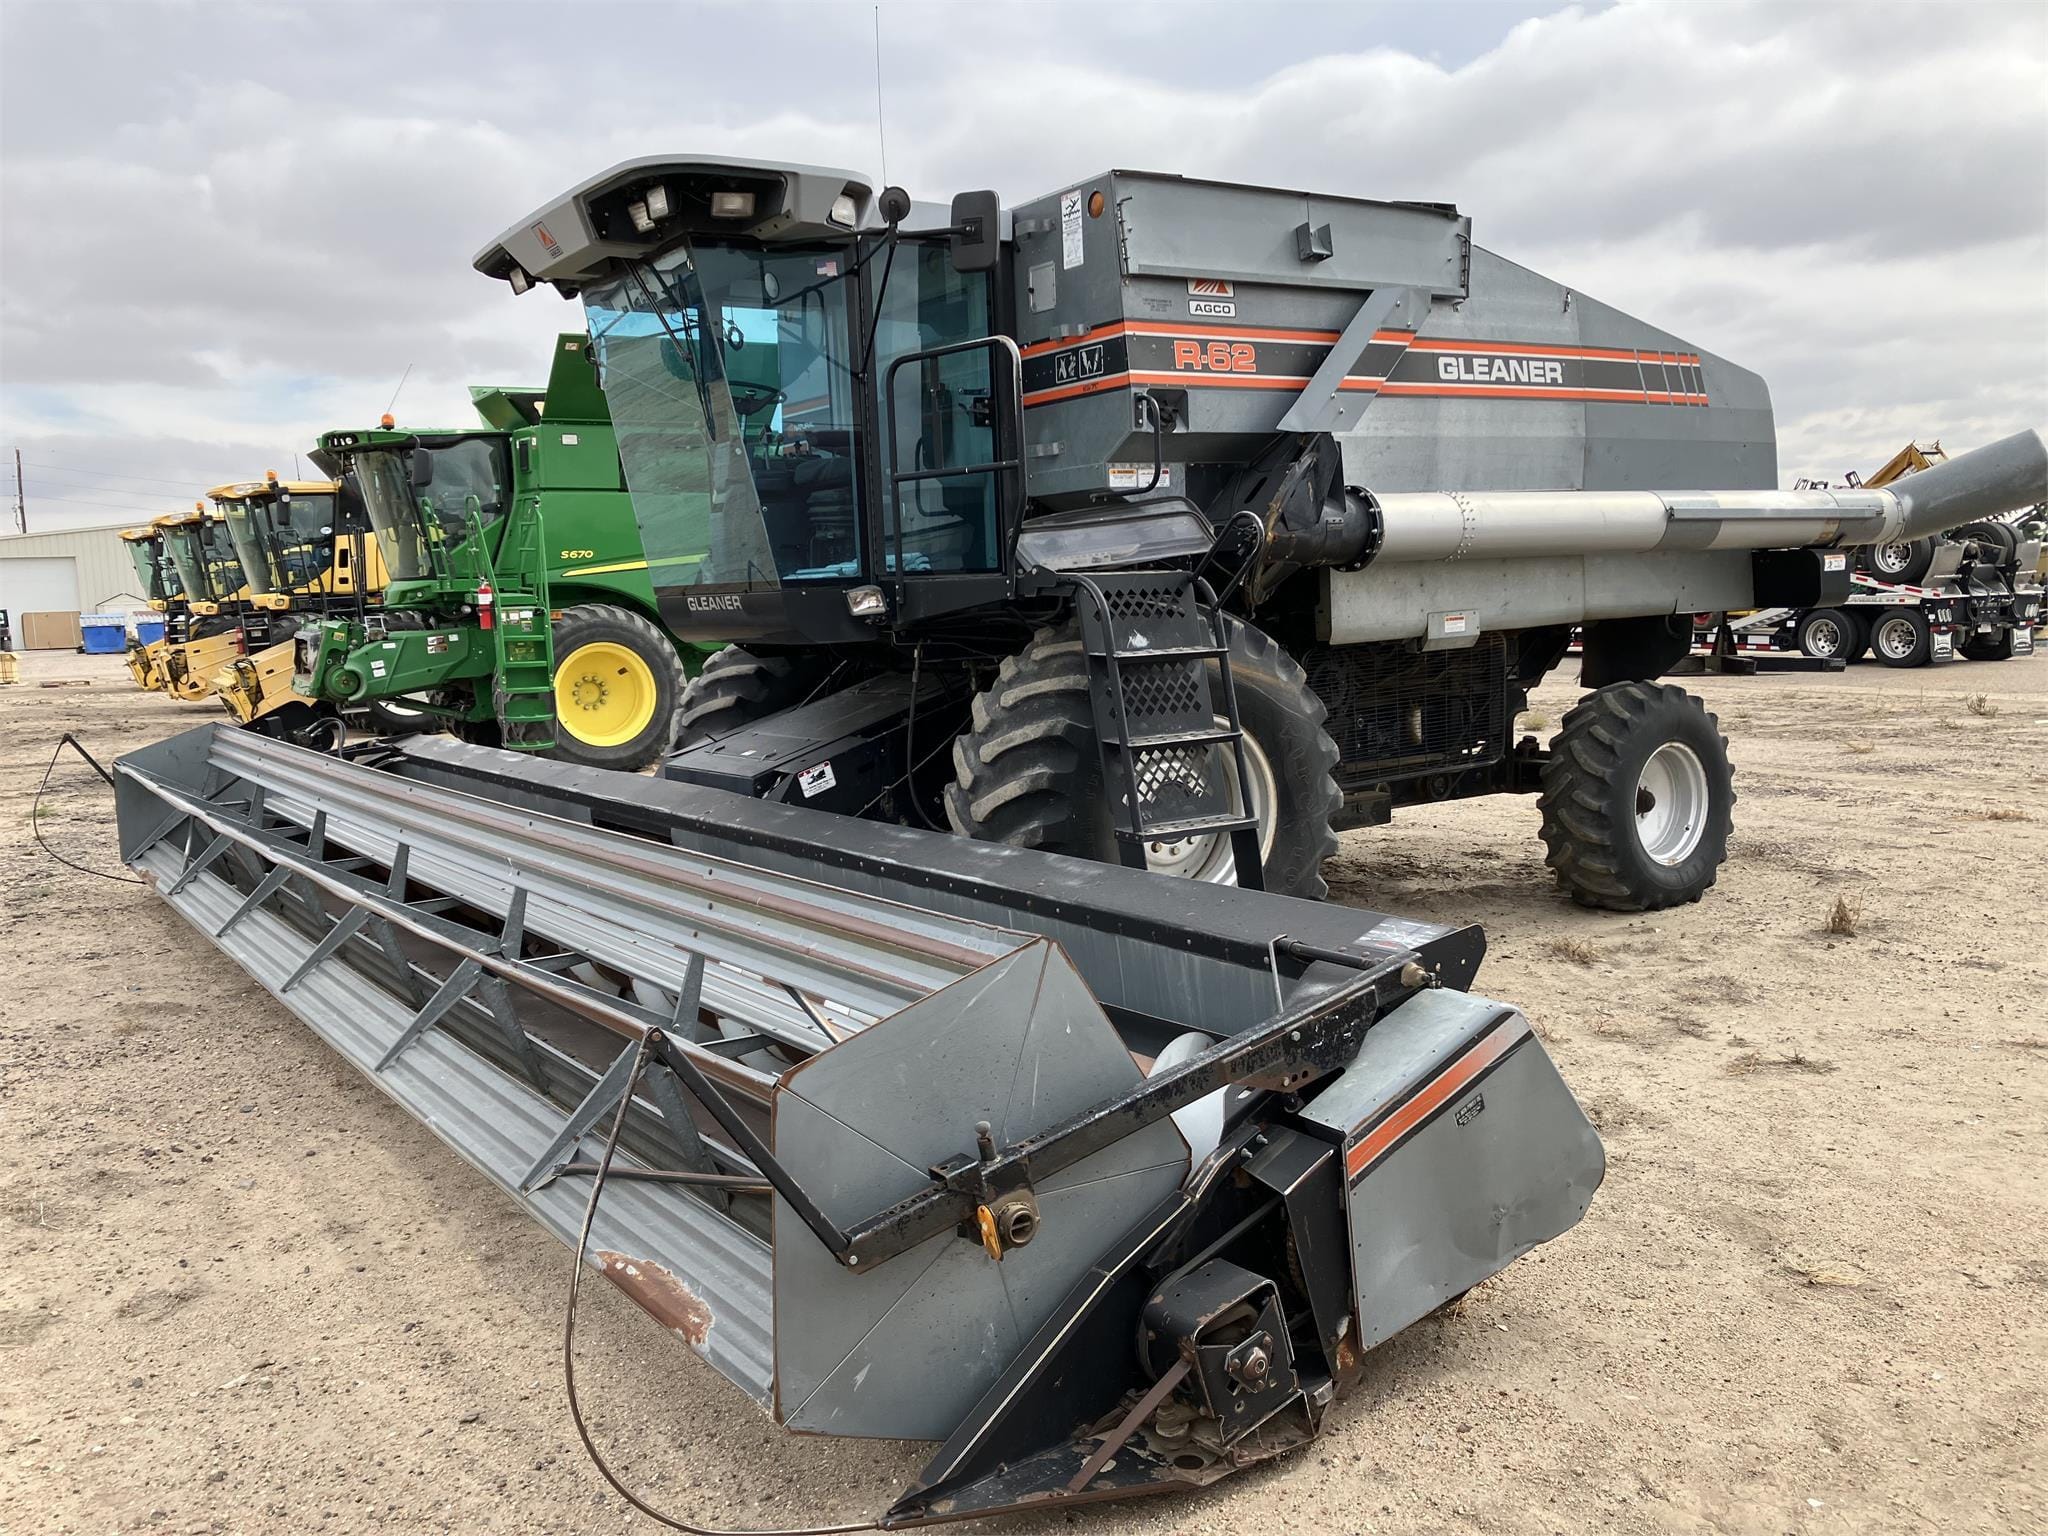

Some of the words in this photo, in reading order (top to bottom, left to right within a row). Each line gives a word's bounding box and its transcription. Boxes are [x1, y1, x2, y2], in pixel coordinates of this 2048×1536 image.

[1194, 303, 1231, 314] AGCO
[1173, 340, 1257, 373] R-62
[1438, 356, 1563, 384] GLEANER
[560, 550, 594, 559] S670
[687, 595, 743, 611] GLEANER
